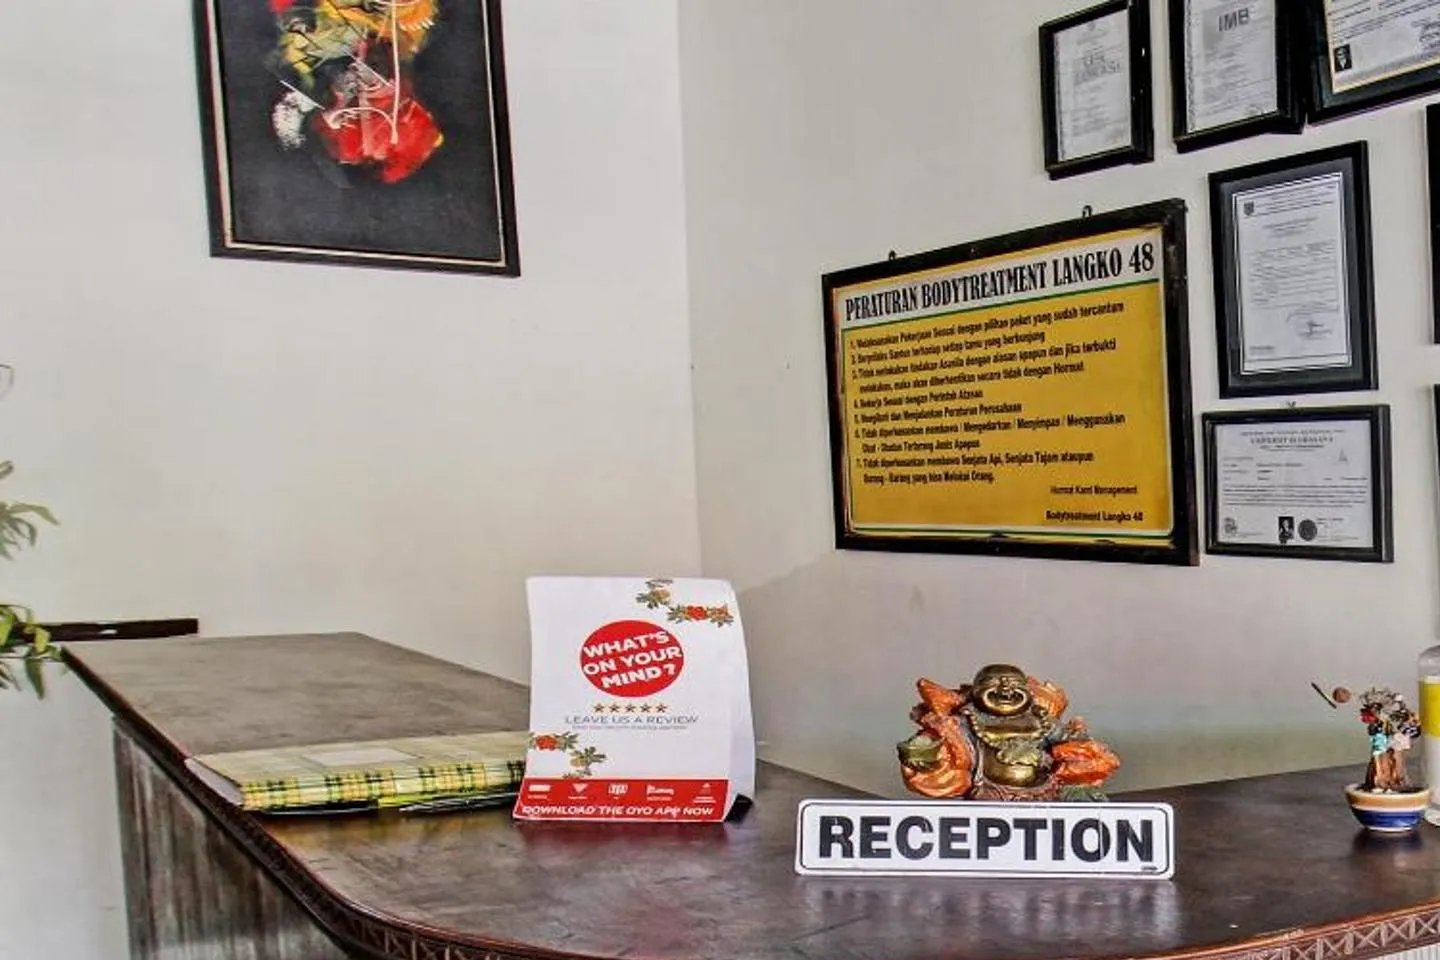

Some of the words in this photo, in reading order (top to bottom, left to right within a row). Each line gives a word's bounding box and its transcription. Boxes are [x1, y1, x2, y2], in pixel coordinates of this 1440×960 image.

[1218, 8, 1250, 32] IMB
[845, 287, 919, 321] PERATURAN
[921, 261, 1047, 309] BODYTREATMENT
[1052, 247, 1122, 287] LANGKO
[1128, 242, 1154, 274] 48
[1033, 313, 1052, 327] yang
[1053, 308, 1078, 321] sudah
[1102, 511, 1131, 523] Langko
[1132, 511, 1144, 521] 48
[584, 631, 670, 658] WHAT'S
[583, 660, 617, 676] ON
[620, 645, 683, 668] YOUR
[565, 715, 609, 725] LEAVE
[611, 715, 631, 725] US
[633, 715, 645, 725] A
[646, 714, 699, 725] REVIEW
[522, 805, 597, 816] DOWNLOAD
[599, 805, 623, 816] THE
[624, 805, 653, 816] OYO
[655, 805, 681, 818] APP
[683, 806, 714, 816] NOW
[818, 815, 1154, 863] RECEPTION
